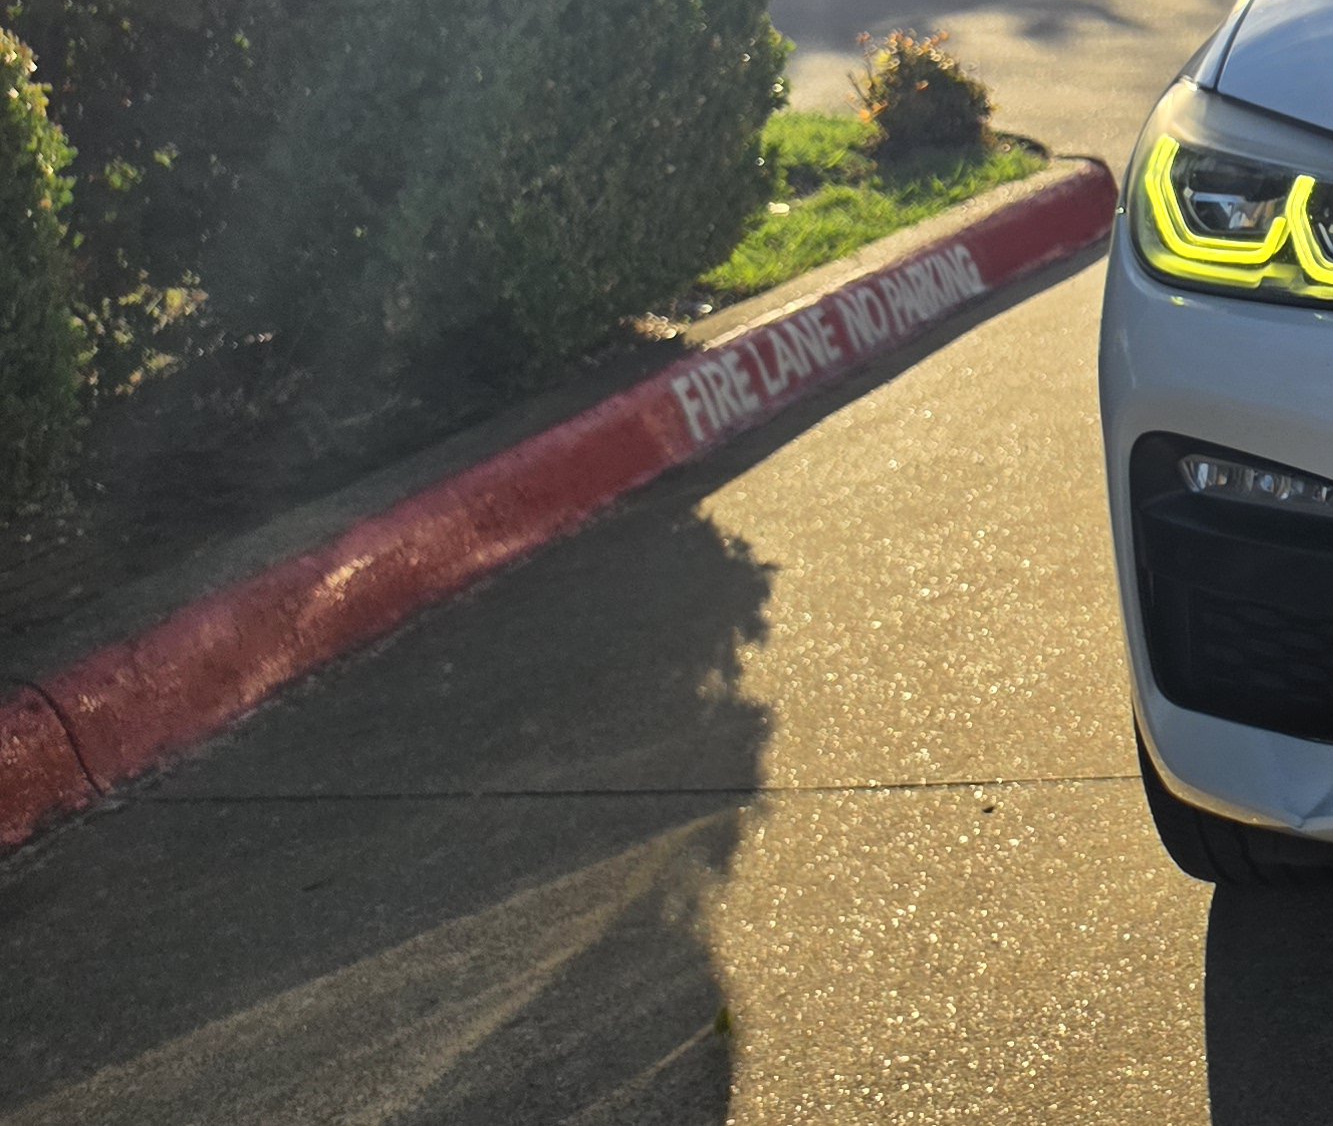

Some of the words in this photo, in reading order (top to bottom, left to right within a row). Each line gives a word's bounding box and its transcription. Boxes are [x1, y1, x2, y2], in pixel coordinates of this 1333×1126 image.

[671, 349, 761, 441] FIRE
[750, 307, 844, 397] LANE
[834, 285, 889, 350] NO
[880, 243, 987, 335] PARKING
